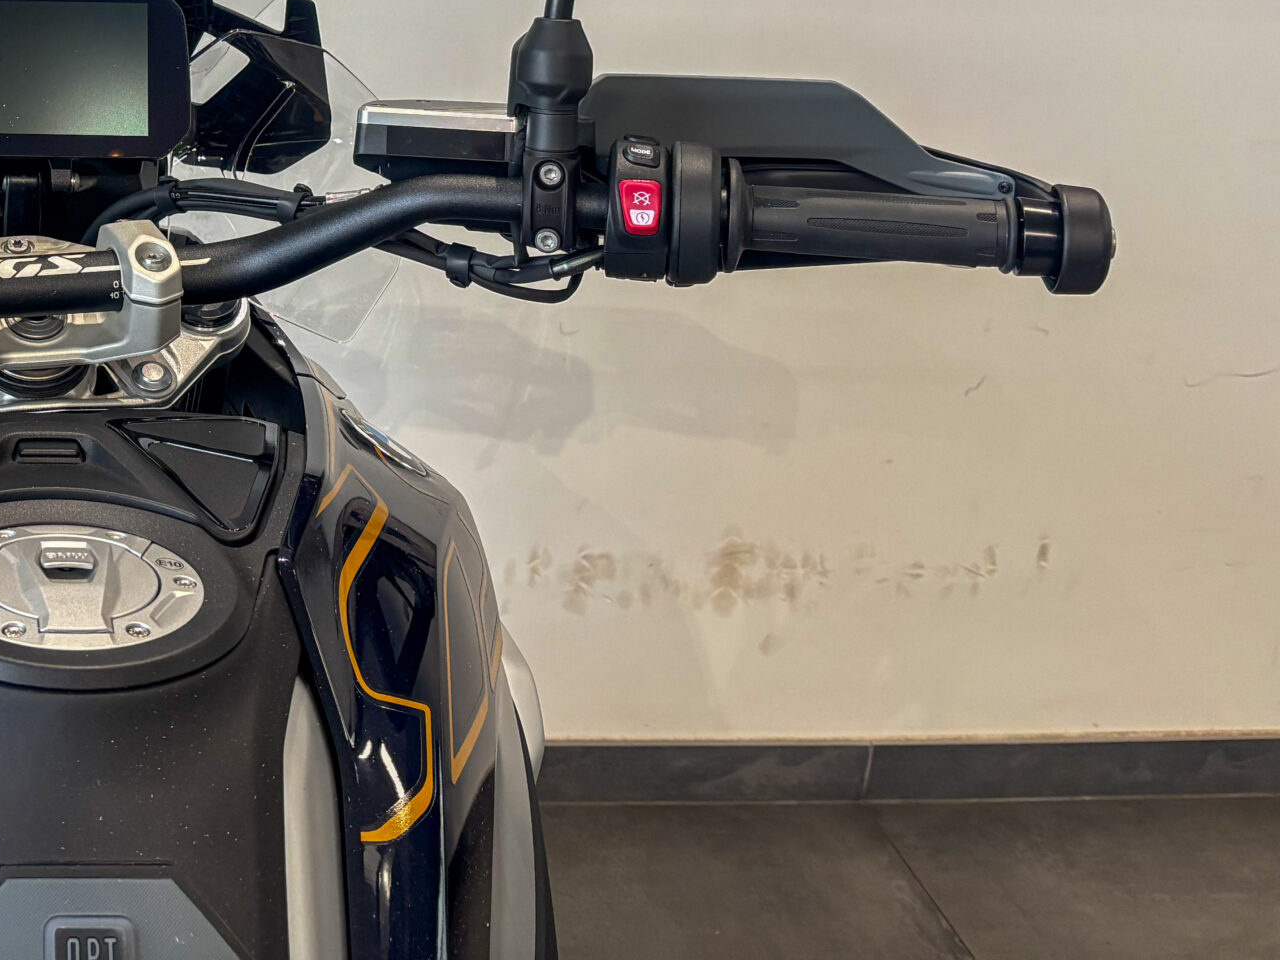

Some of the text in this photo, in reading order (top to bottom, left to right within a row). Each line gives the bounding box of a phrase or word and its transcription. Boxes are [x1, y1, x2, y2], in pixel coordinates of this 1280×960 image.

[630, 146, 651, 155] MODE
[113, 280, 120, 289] 0
[110, 291, 120, 299] 10
[158, 559, 182, 568] E10
